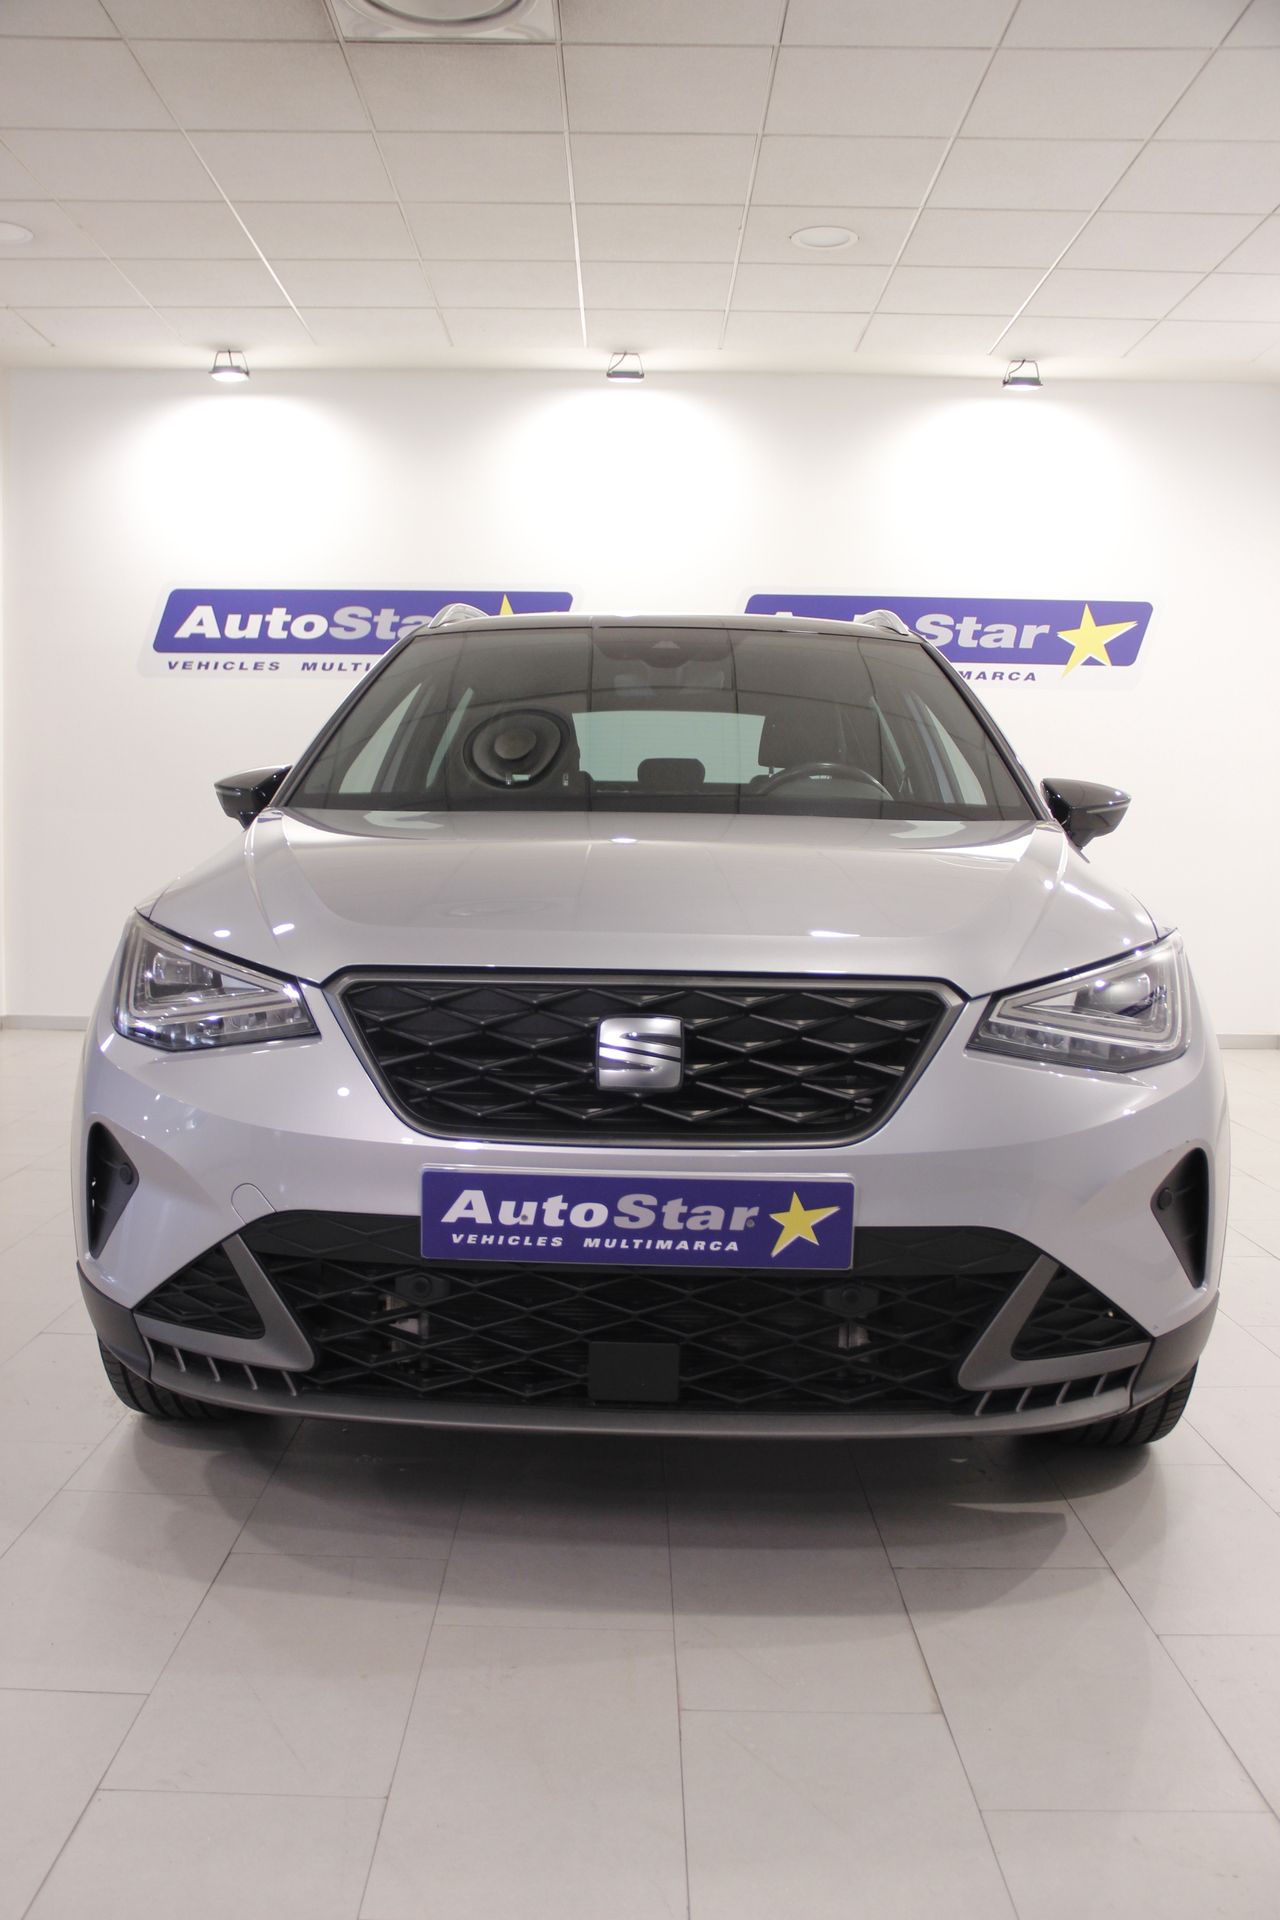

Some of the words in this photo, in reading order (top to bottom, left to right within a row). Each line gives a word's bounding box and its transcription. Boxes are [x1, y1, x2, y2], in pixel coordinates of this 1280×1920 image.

[173, 605, 433, 641] AutoSta
[915, 613, 1050, 649] Star
[167, 660, 281, 672] VEHICLES
[301, 661, 371, 672] MULTI
[958, 670, 1037, 682] MARCA
[440, 1189, 760, 1231] AutoStar
[451, 1233, 564, 1248] VEHICLES
[583, 1237, 740, 1252] MULTIMARCA
